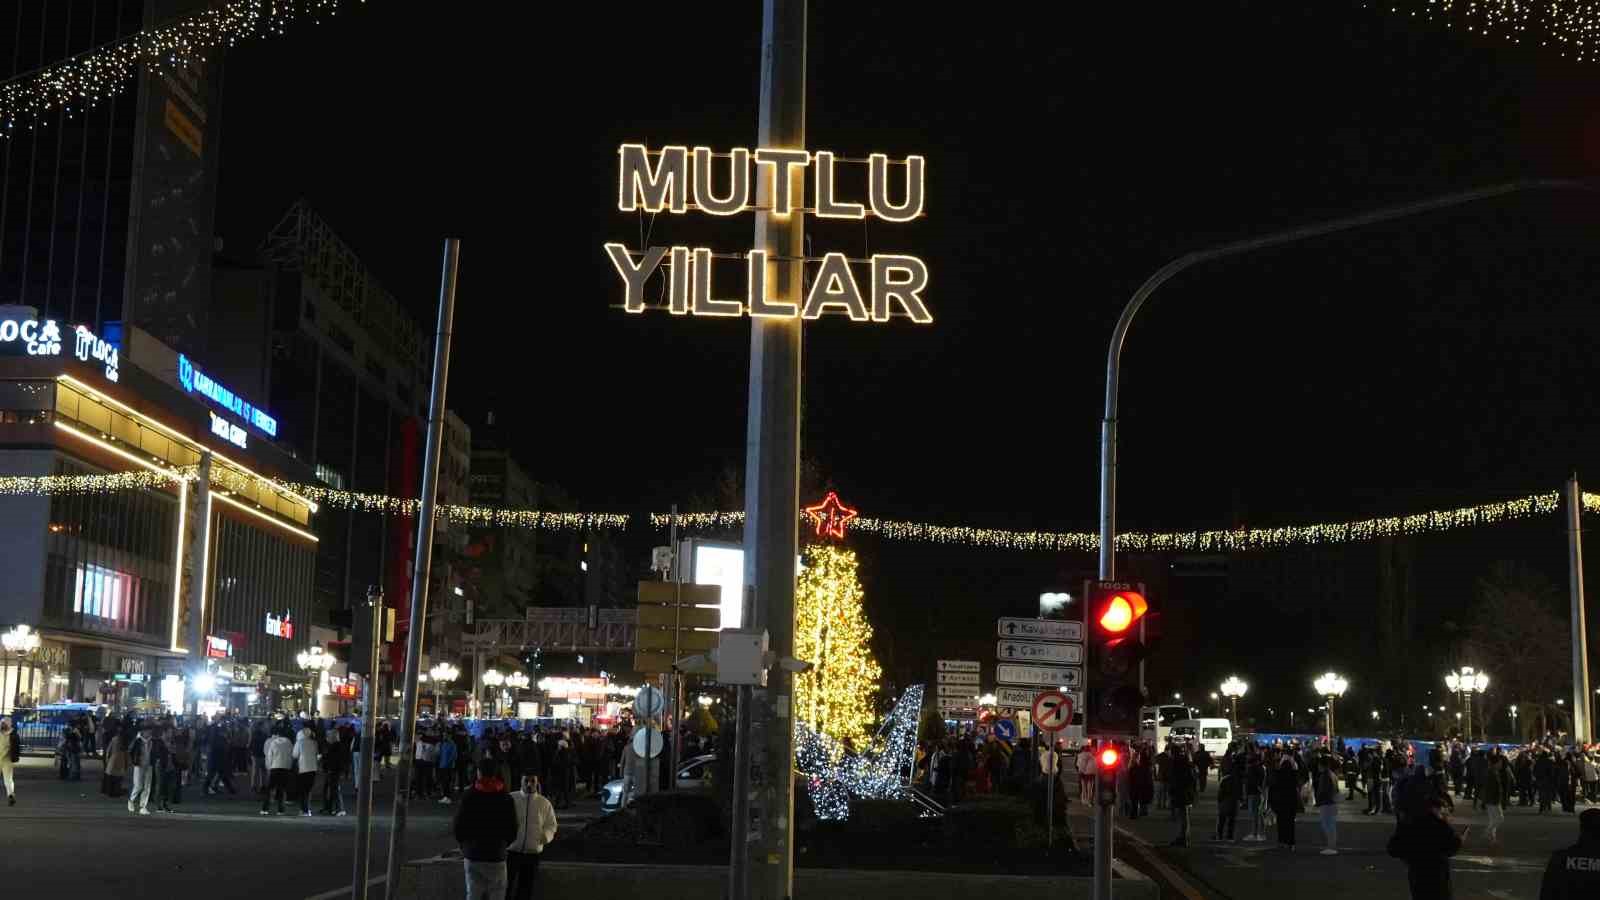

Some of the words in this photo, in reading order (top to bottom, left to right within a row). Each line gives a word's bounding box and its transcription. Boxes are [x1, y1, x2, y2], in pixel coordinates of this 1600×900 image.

[618, 144, 926, 222] MUTLU
[604, 243, 934, 323] YILLAR
[0, 319, 62, 342] OCA
[27, 340, 62, 356] Cafe
[91, 335, 119, 370] LOCA
